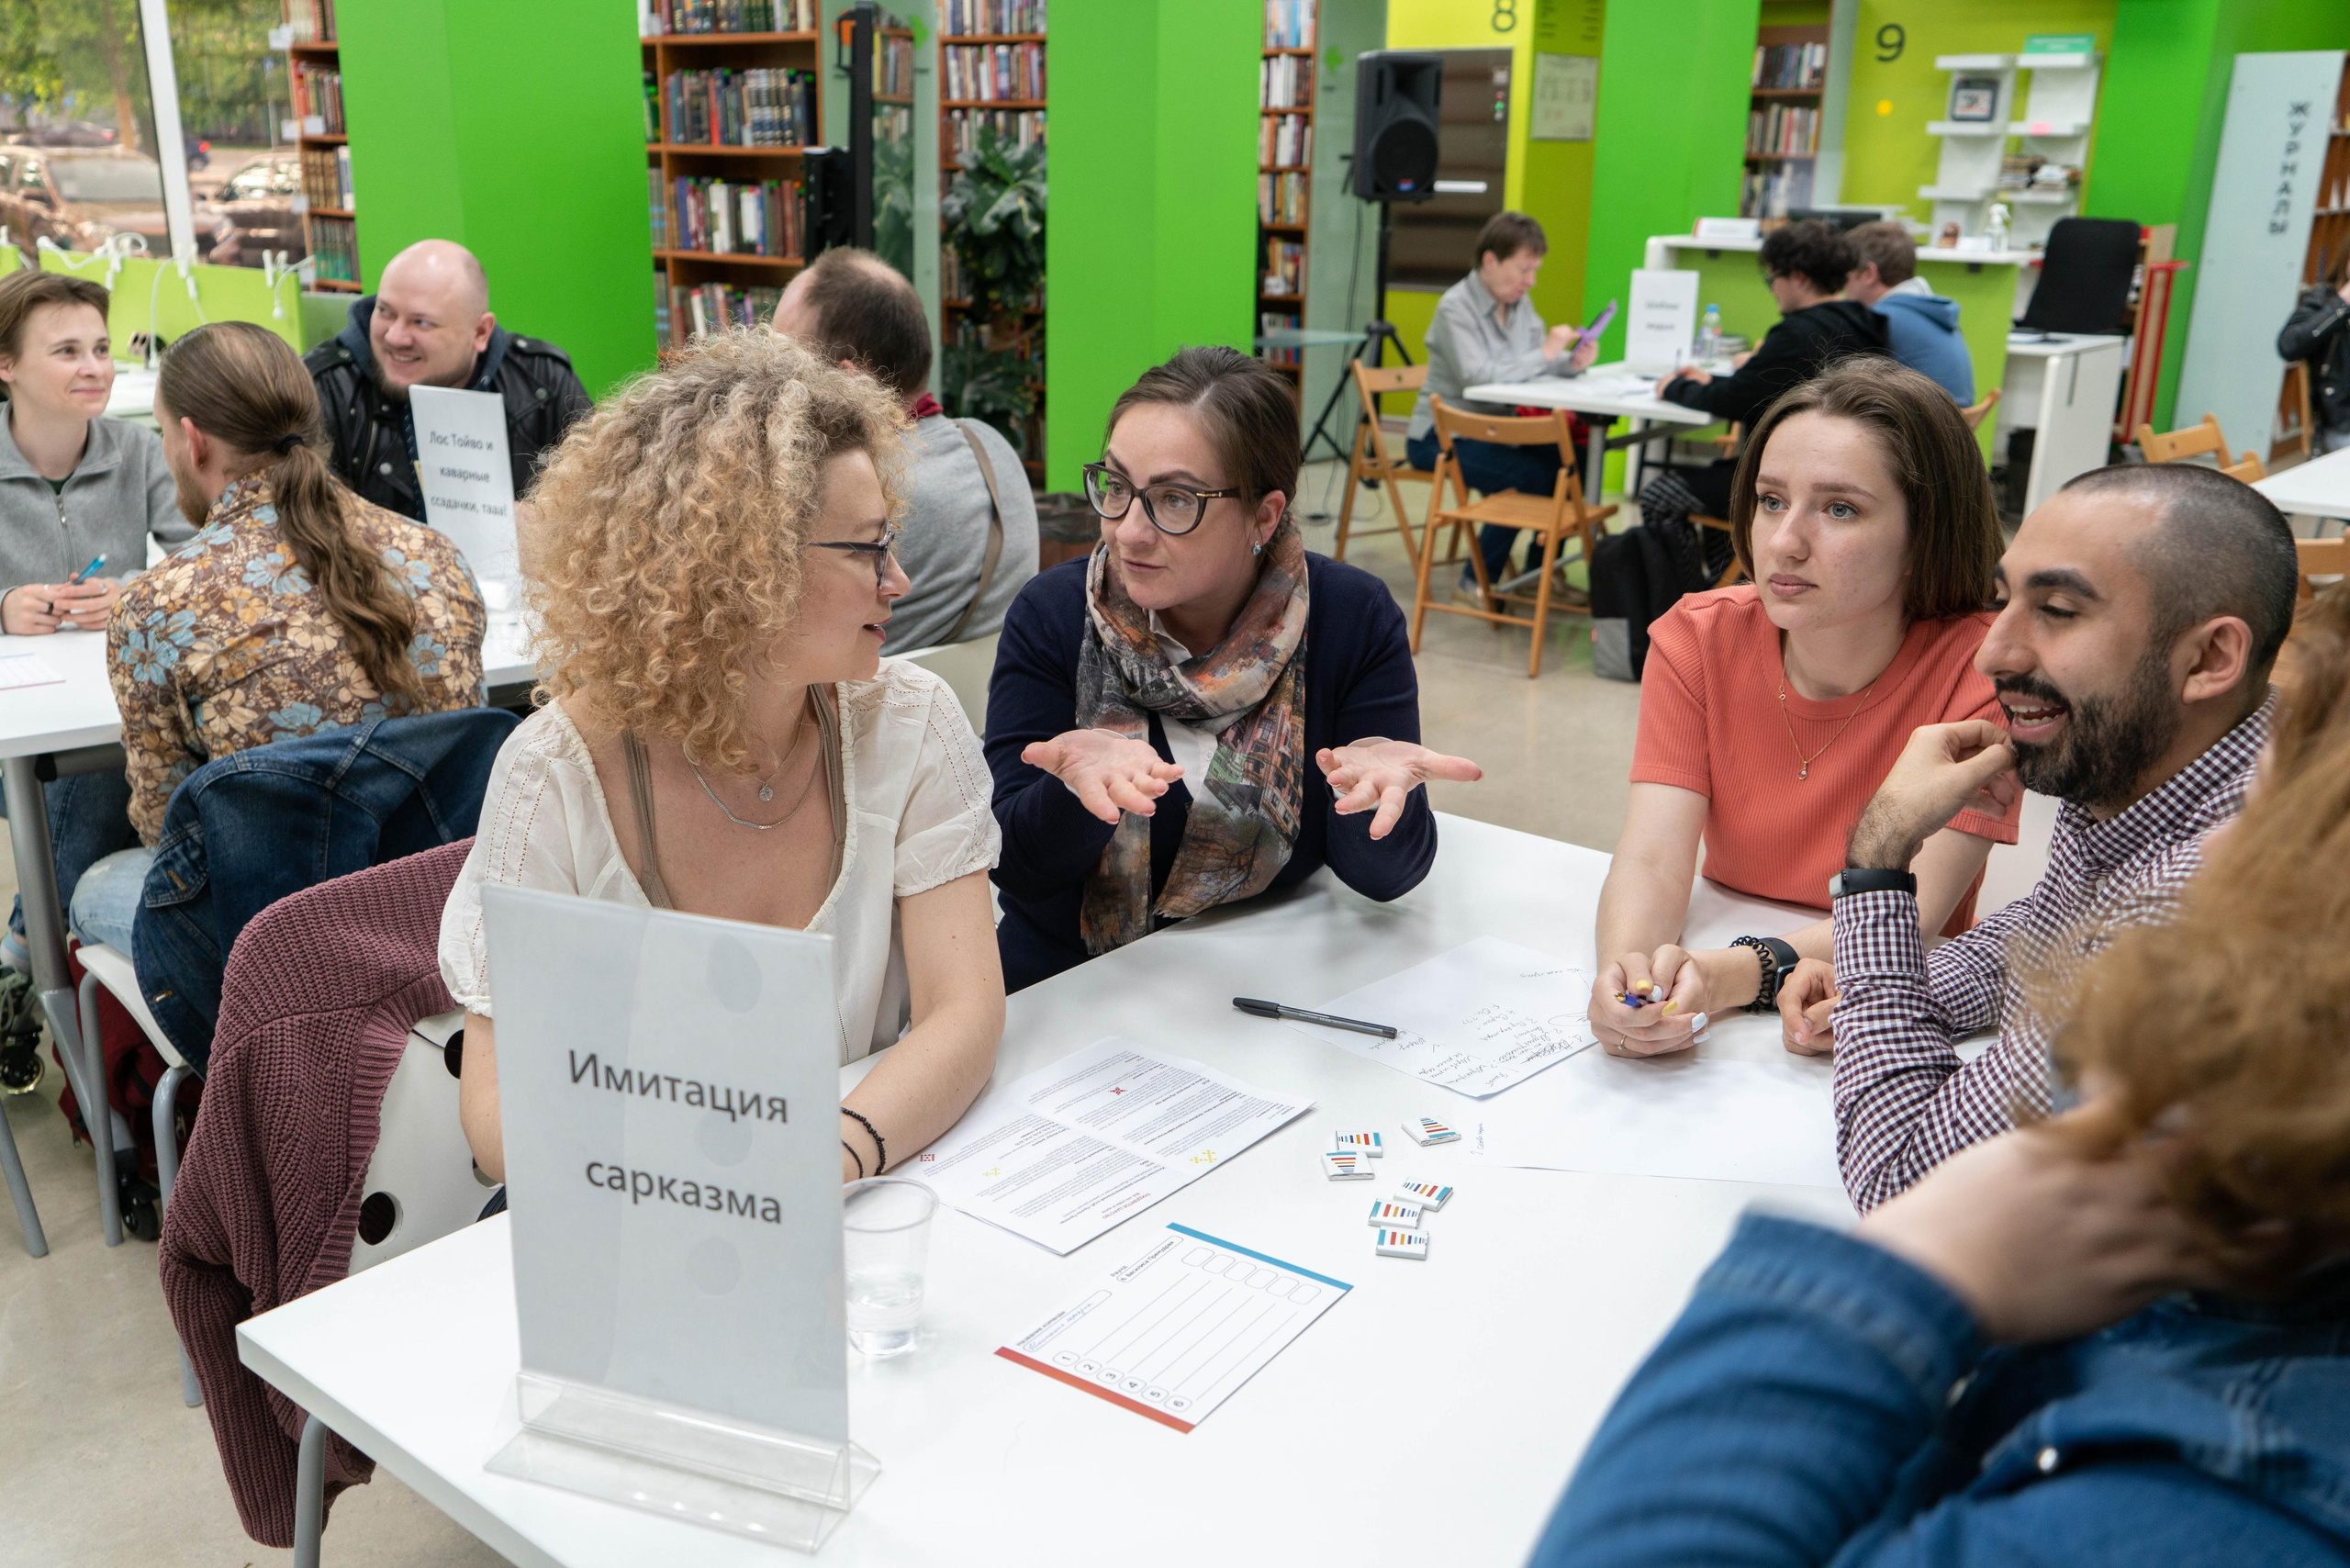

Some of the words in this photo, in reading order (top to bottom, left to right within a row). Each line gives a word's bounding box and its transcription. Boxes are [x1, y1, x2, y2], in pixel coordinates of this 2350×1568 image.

[1875, 23, 1906, 62] 9
[2268, 101, 2312, 236] ЖУРНАЛЫ
[451, 433, 484, 450] Тойво
[486, 440, 494, 451] и
[567, 1048, 789, 1125] Имитация
[584, 1159, 783, 1225] сарказма
